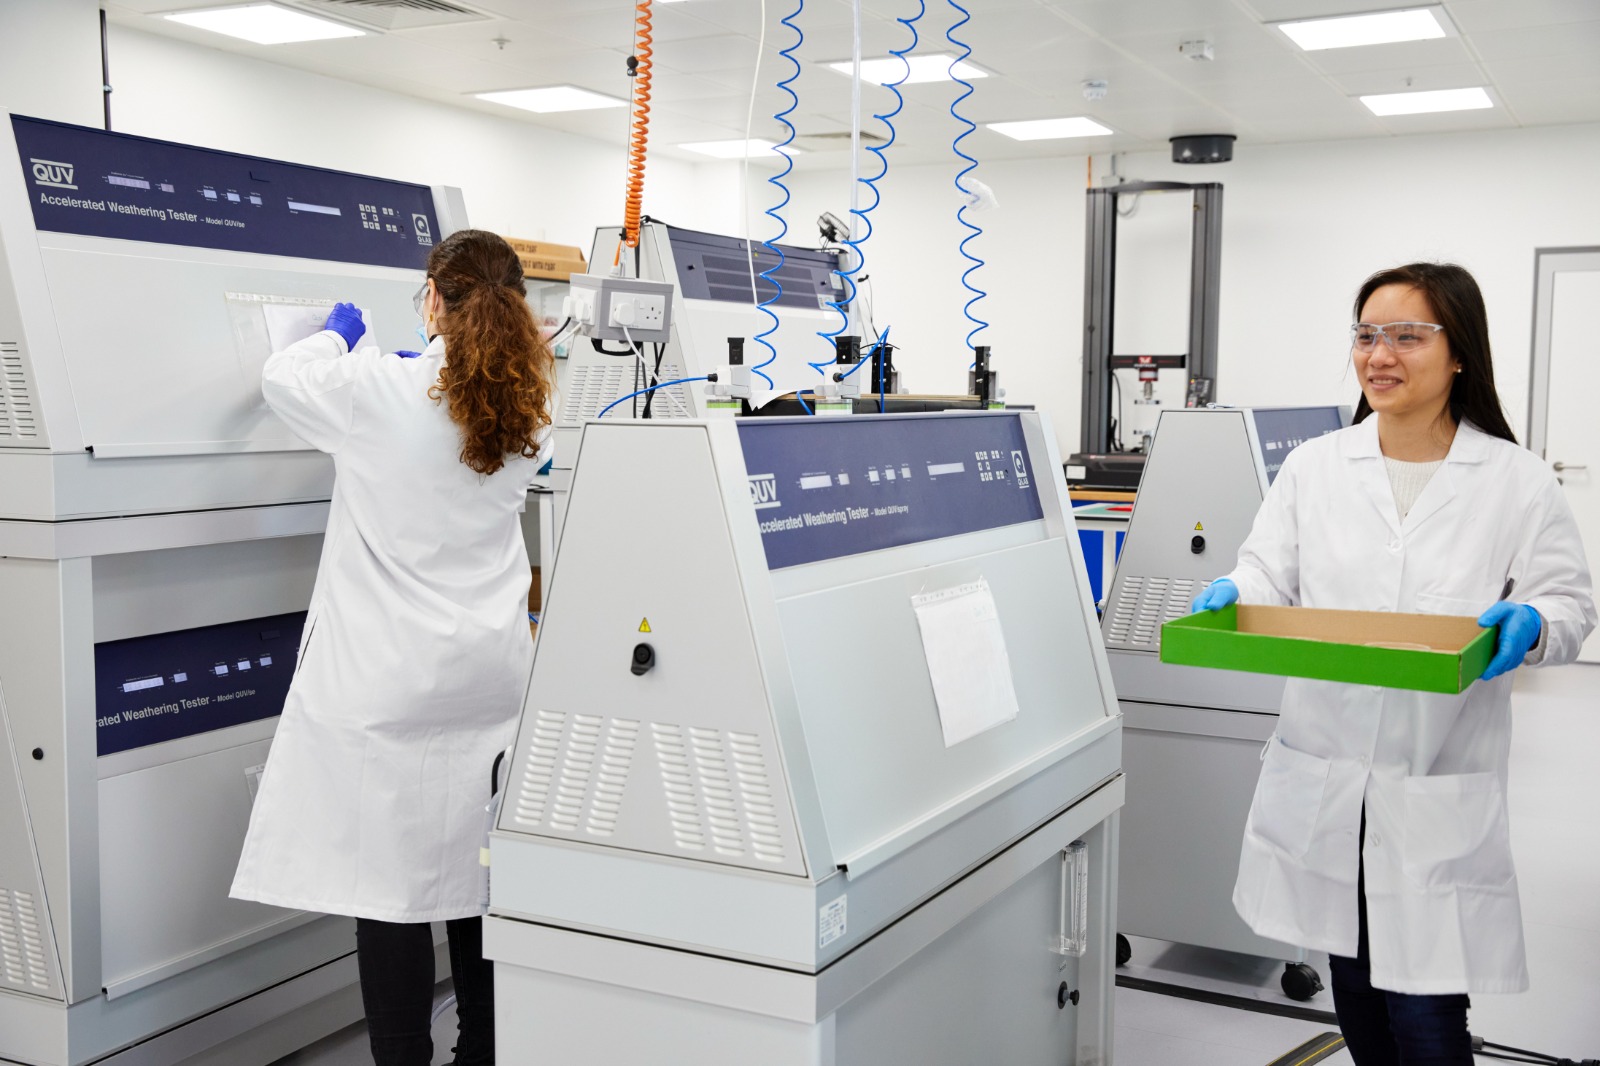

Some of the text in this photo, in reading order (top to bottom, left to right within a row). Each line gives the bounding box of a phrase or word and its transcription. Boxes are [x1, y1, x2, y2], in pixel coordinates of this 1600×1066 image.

[32, 163, 74, 184] QUV
[40, 192, 106, 212] Accelerated
[108, 200, 166, 220] Weathering
[167, 208, 198, 222] Tester
[206, 217, 224, 226] Model
[760, 516, 803, 534] ccelerated
[804, 509, 847, 527] Weathering
[847, 506, 870, 520] Tester
[874, 508, 888, 516] Model
[122, 702, 180, 722] Weathering
[180, 696, 210, 710] Tester
[218, 692, 234, 702] Model
